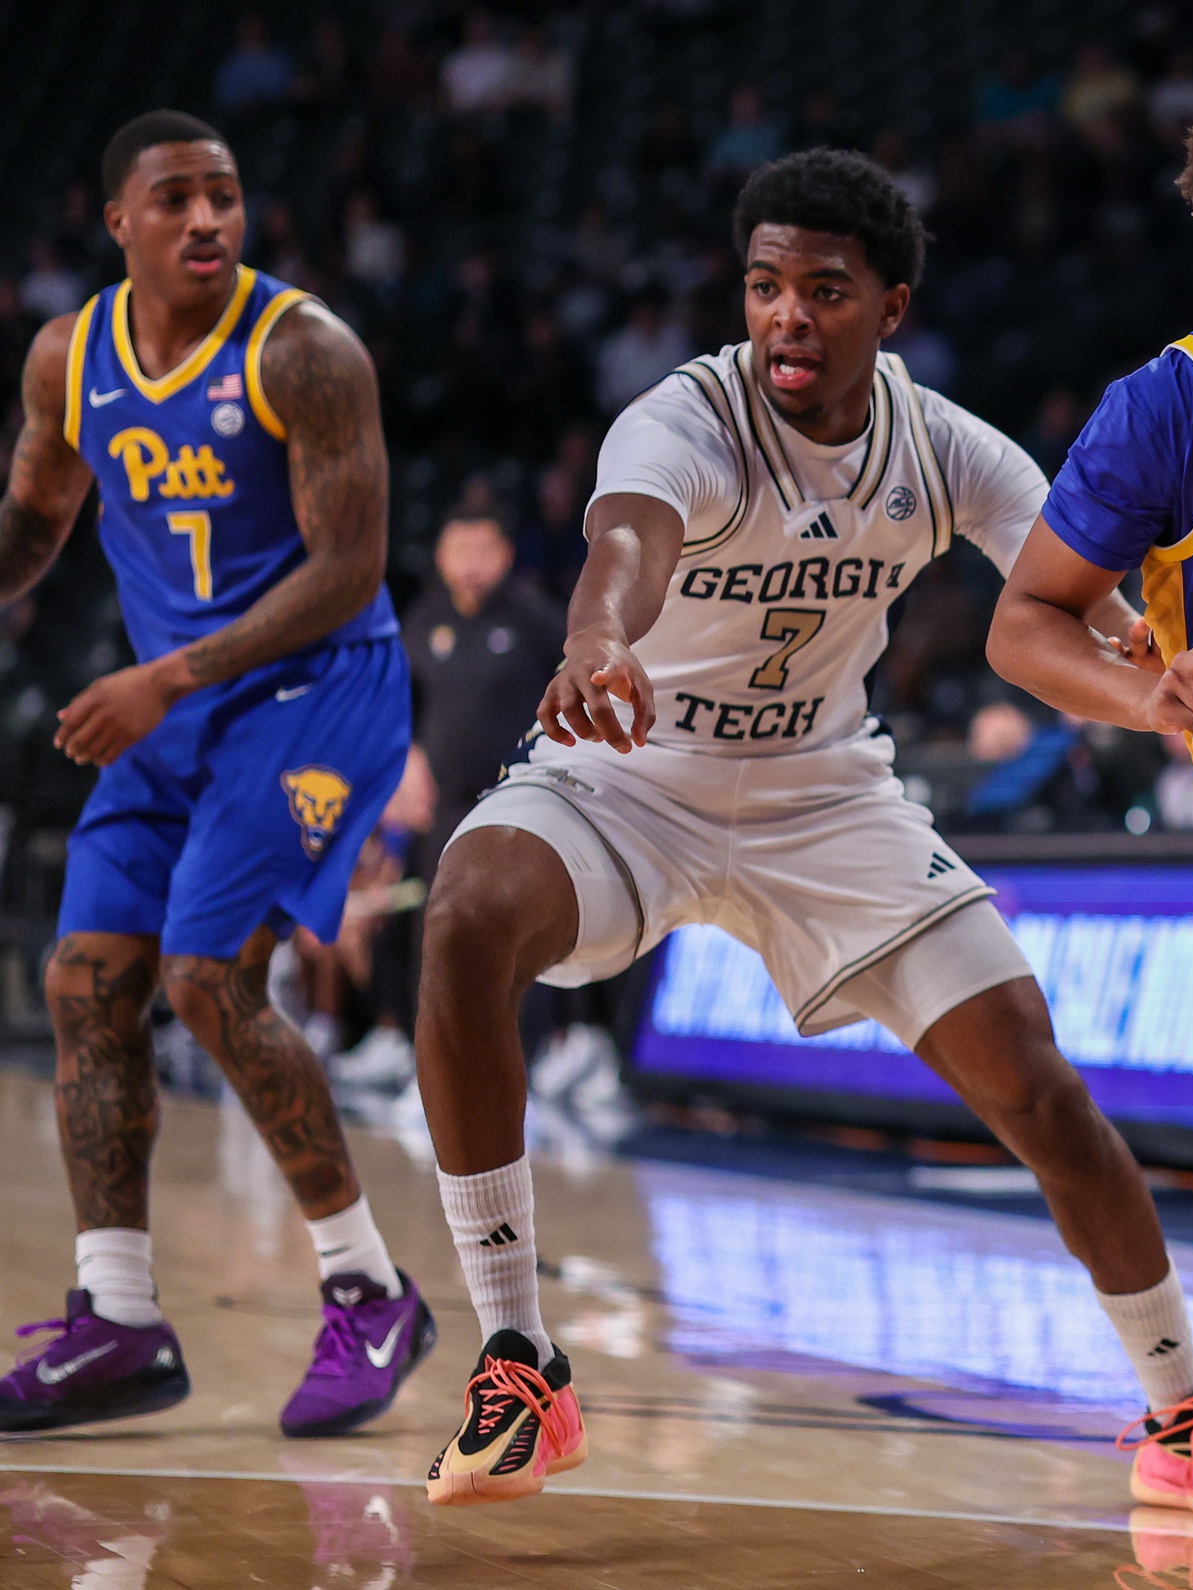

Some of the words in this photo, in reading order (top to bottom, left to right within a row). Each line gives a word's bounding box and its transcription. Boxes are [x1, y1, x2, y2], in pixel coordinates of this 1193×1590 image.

[108, 426, 235, 502] Pitt
[166, 510, 213, 602] 7
[748, 608, 827, 691] 7
[674, 692, 826, 741] TECH
